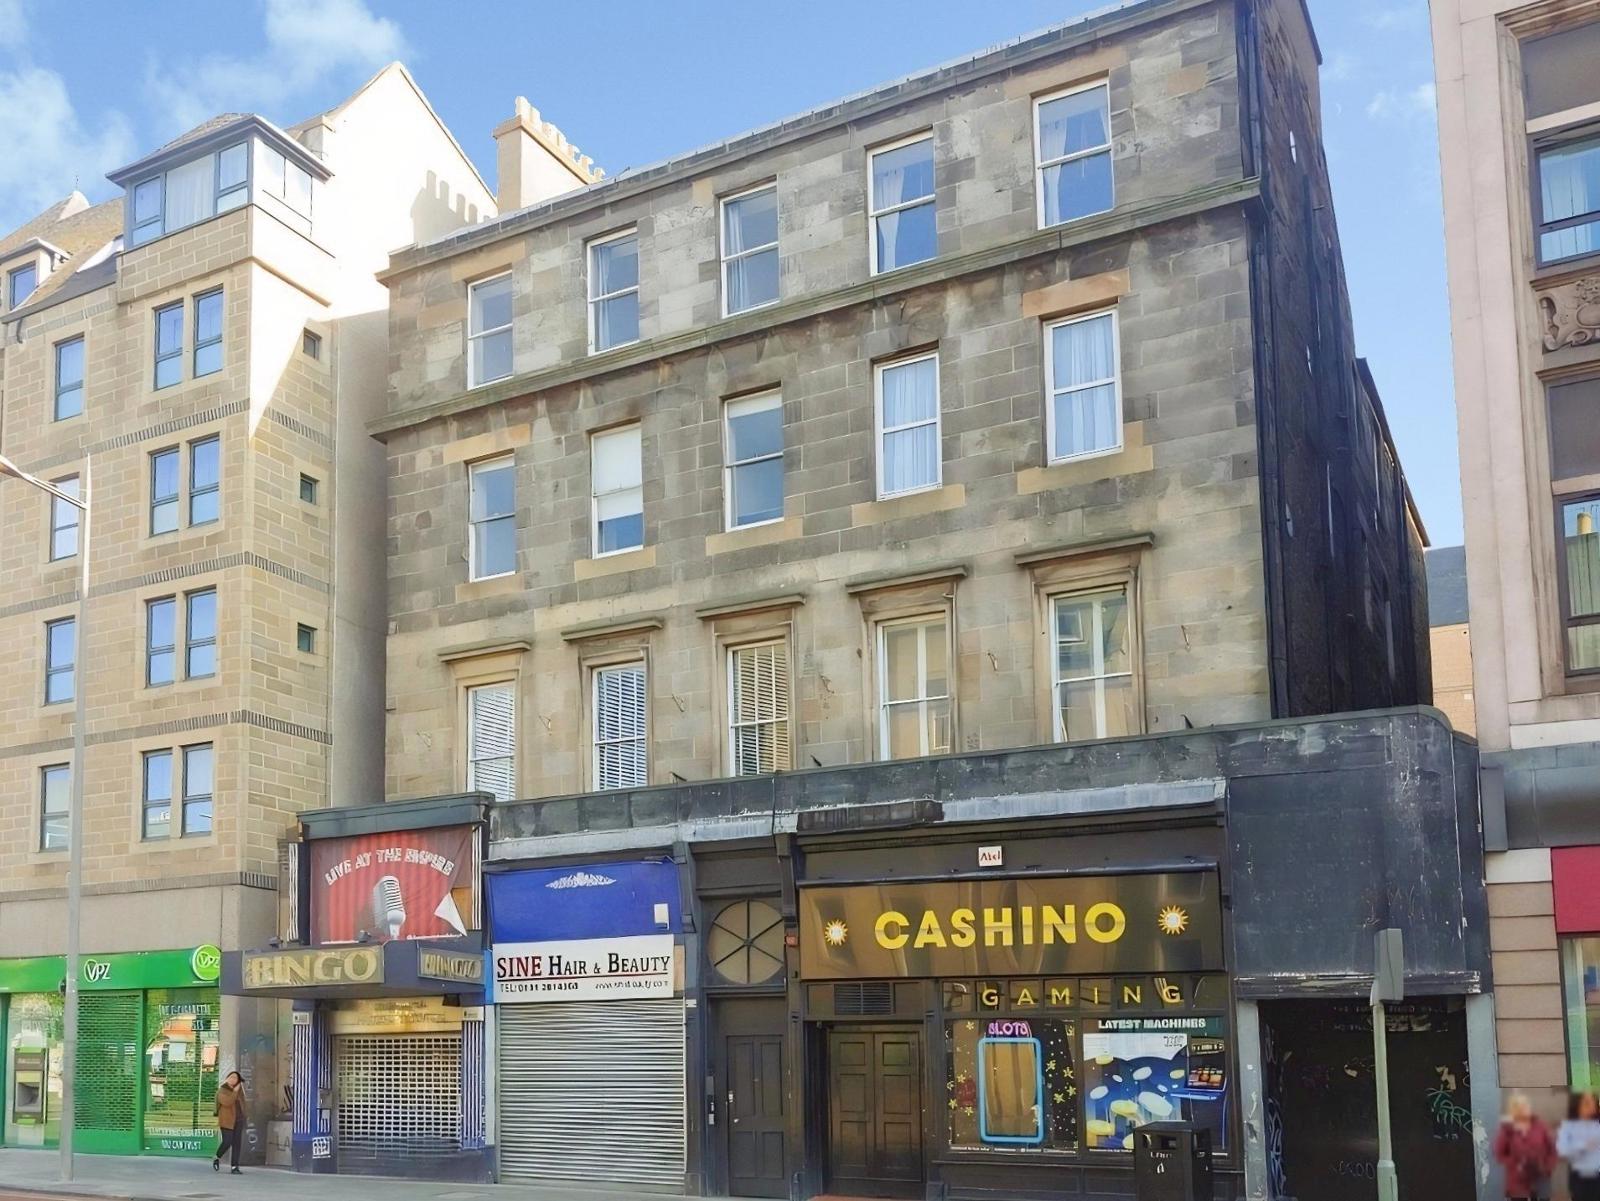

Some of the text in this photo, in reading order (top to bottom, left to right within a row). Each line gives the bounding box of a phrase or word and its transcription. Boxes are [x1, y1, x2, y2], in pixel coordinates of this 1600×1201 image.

[376, 848, 402, 863] THE
[874, 902, 1126, 950] CASHINO
[84, 959, 111, 983] VPZ
[245, 949, 378, 986] BINGO
[497, 956, 542, 978] SINE
[593, 962, 601, 974] &
[981, 984, 1182, 1007] GAMING
[1098, 1017, 1207, 1030] LATEST MACHINES
